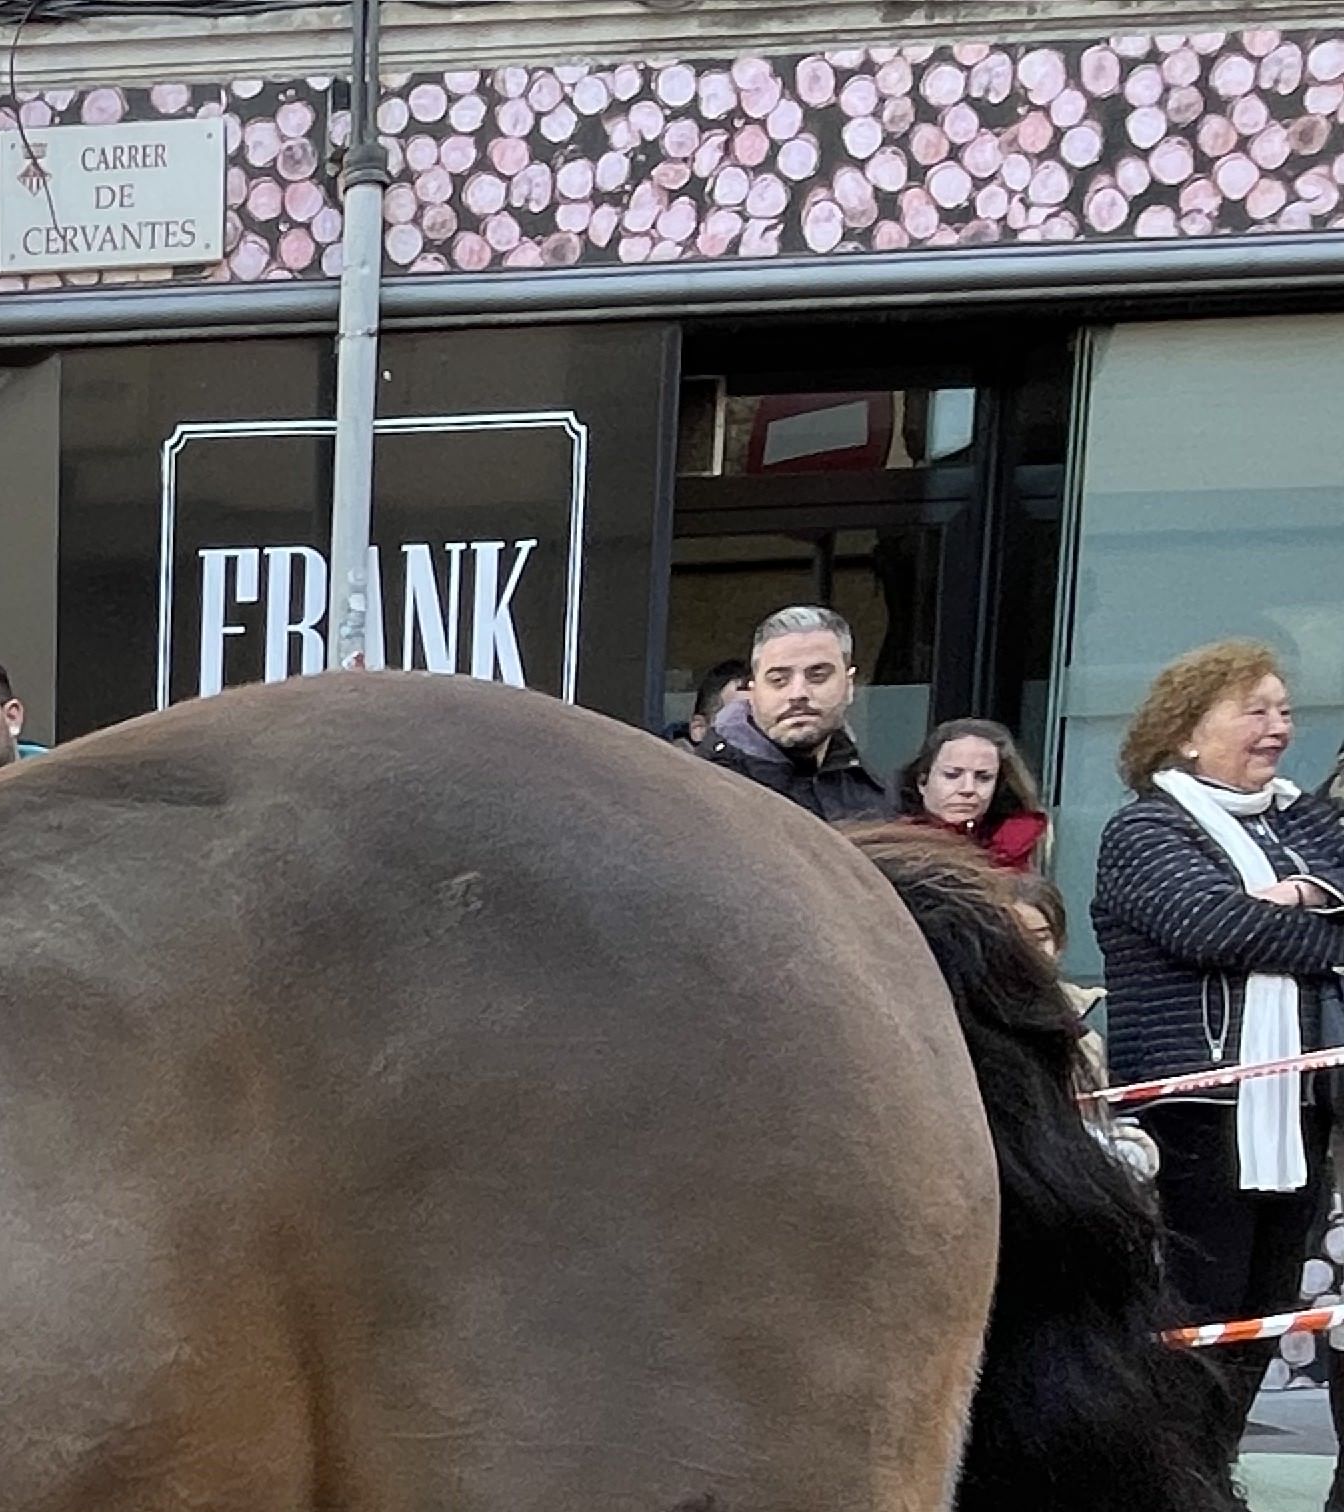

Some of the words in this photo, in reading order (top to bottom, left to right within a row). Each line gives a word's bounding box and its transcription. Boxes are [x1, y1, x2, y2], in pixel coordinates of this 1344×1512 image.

[80, 144, 168, 172] CARRER
[94, 184, 136, 210] DE
[22, 219, 196, 256] CERVANTES
